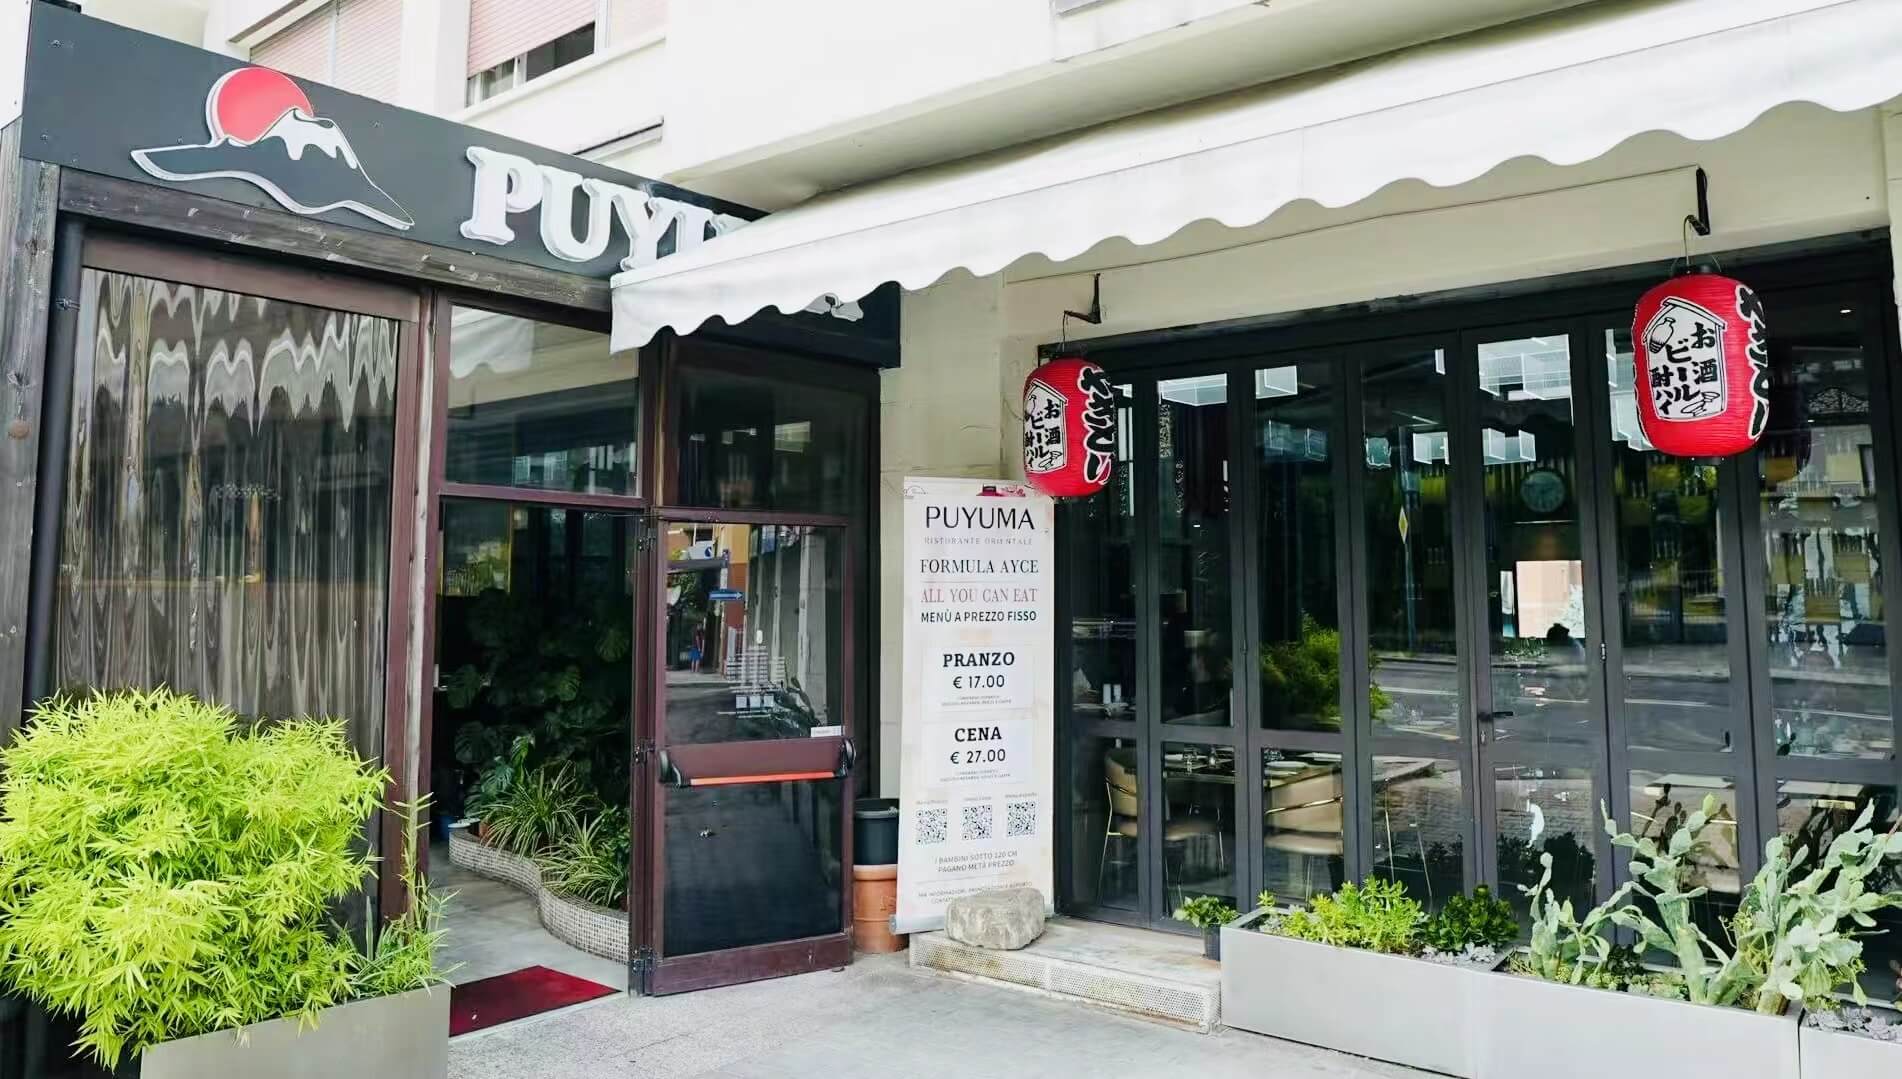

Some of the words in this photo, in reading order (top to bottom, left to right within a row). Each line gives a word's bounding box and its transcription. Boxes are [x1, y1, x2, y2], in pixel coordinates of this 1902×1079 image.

[1691, 322, 1718, 384] お酒
[1044, 399, 1061, 445] お酒
[926, 506, 1036, 530] PUYUMA
[920, 559, 994, 574] FORMULA
[1000, 559, 1039, 574] AYCE
[920, 588, 945, 603] ALL
[949, 588, 978, 603] YOU
[982, 588, 1010, 603] CAN
[1013, 587, 1038, 602] EAT
[921, 608, 951, 623] MENÙ
[954, 611, 962, 622] A
[964, 610, 1005, 622] PREZZO
[1007, 610, 1037, 622] FISSO
[943, 651, 1016, 668] PRANZO
[952, 676, 963, 689] €
[968, 674, 1006, 689] 17.00
[954, 726, 1002, 743] CENA
[950, 751, 960, 764] €
[966, 748, 1006, 764] 27.00
[938, 855, 969, 865] BAMBINI
[970, 852, 993, 861] SOTTO
[994, 850, 1007, 859] 120
[1007, 849, 1018, 858] CM
[937, 864, 967, 873] PAGANO
[987, 860, 1015, 869] PREZZO
